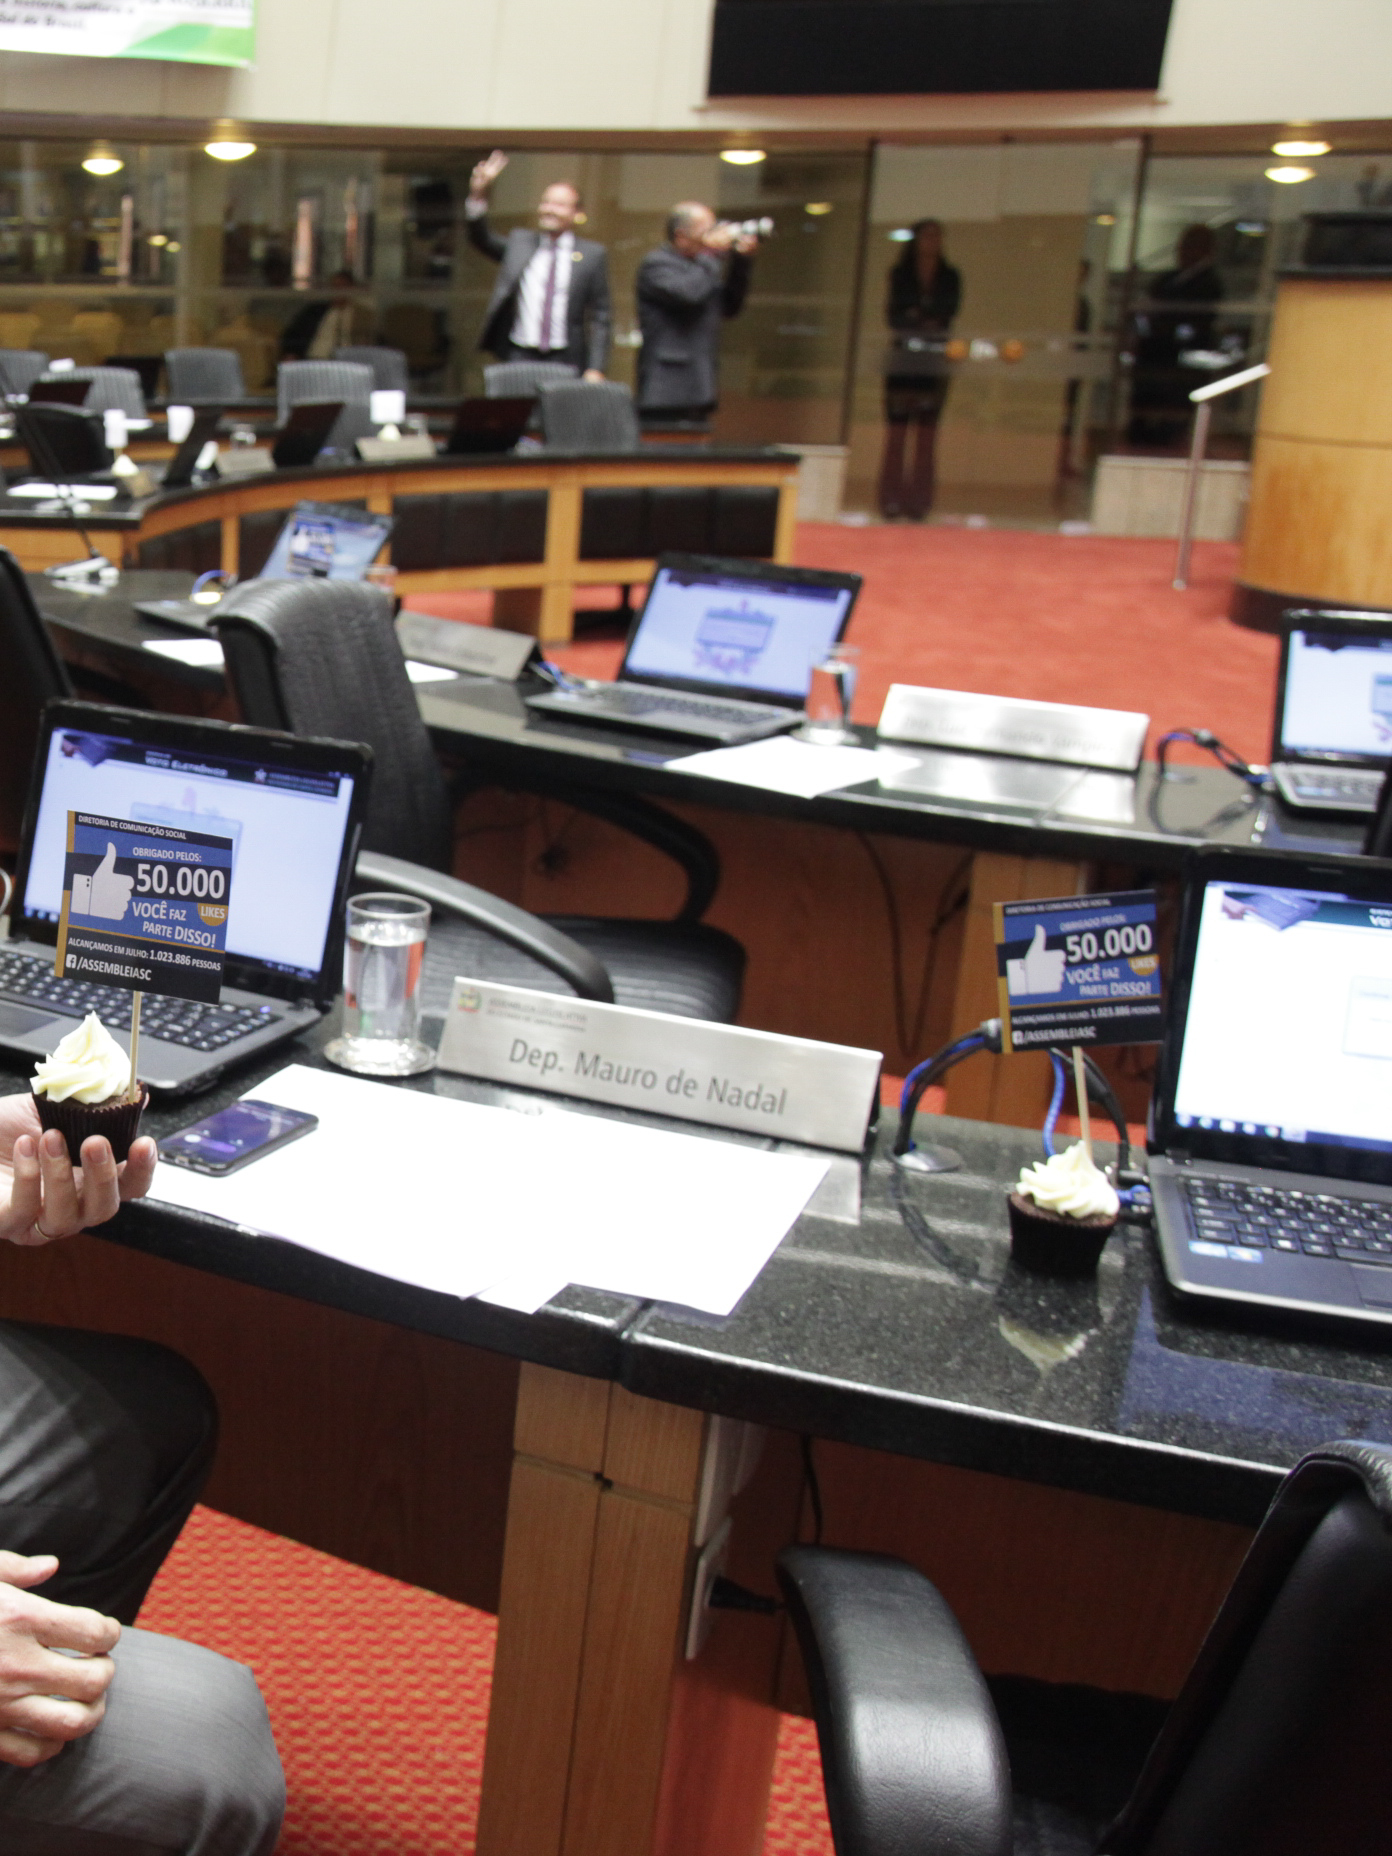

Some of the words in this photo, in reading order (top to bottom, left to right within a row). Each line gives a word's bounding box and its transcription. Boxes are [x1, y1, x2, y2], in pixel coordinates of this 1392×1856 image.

[78, 815, 109, 826] DIRETORIA
[110, 820, 119, 828] DE
[119, 822, 165, 836] COMUNICAÇÃO
[165, 829, 187, 840] SOCIAL
[132, 846, 175, 860] OBRIGADO
[175, 852, 202, 862] PELOS:
[136, 863, 225, 899] 50.000
[132, 901, 168, 920] VOCÊ
[169, 909, 187, 921] FAZ
[200, 906, 225, 919] LIKES
[142, 921, 172, 938] PARTE
[174, 928, 216, 948] DISSO!
[1066, 924, 1153, 962] 50.000
[68, 937, 113, 953] ALCANÇAMOS
[114, 945, 125, 954] EM
[125, 947, 149, 959] JULHO:
[149, 950, 191, 966] 1.023.886
[192, 958, 221, 971] PESSOAS
[1066, 963, 1102, 985] VOCÊ
[1110, 981, 1152, 996] DISSO!
[508, 1038, 565, 1076] Dep.
[575, 1050, 658, 1090] Mauro
[665, 1069, 699, 1098] de
[707, 1077, 788, 1116] Nadal
